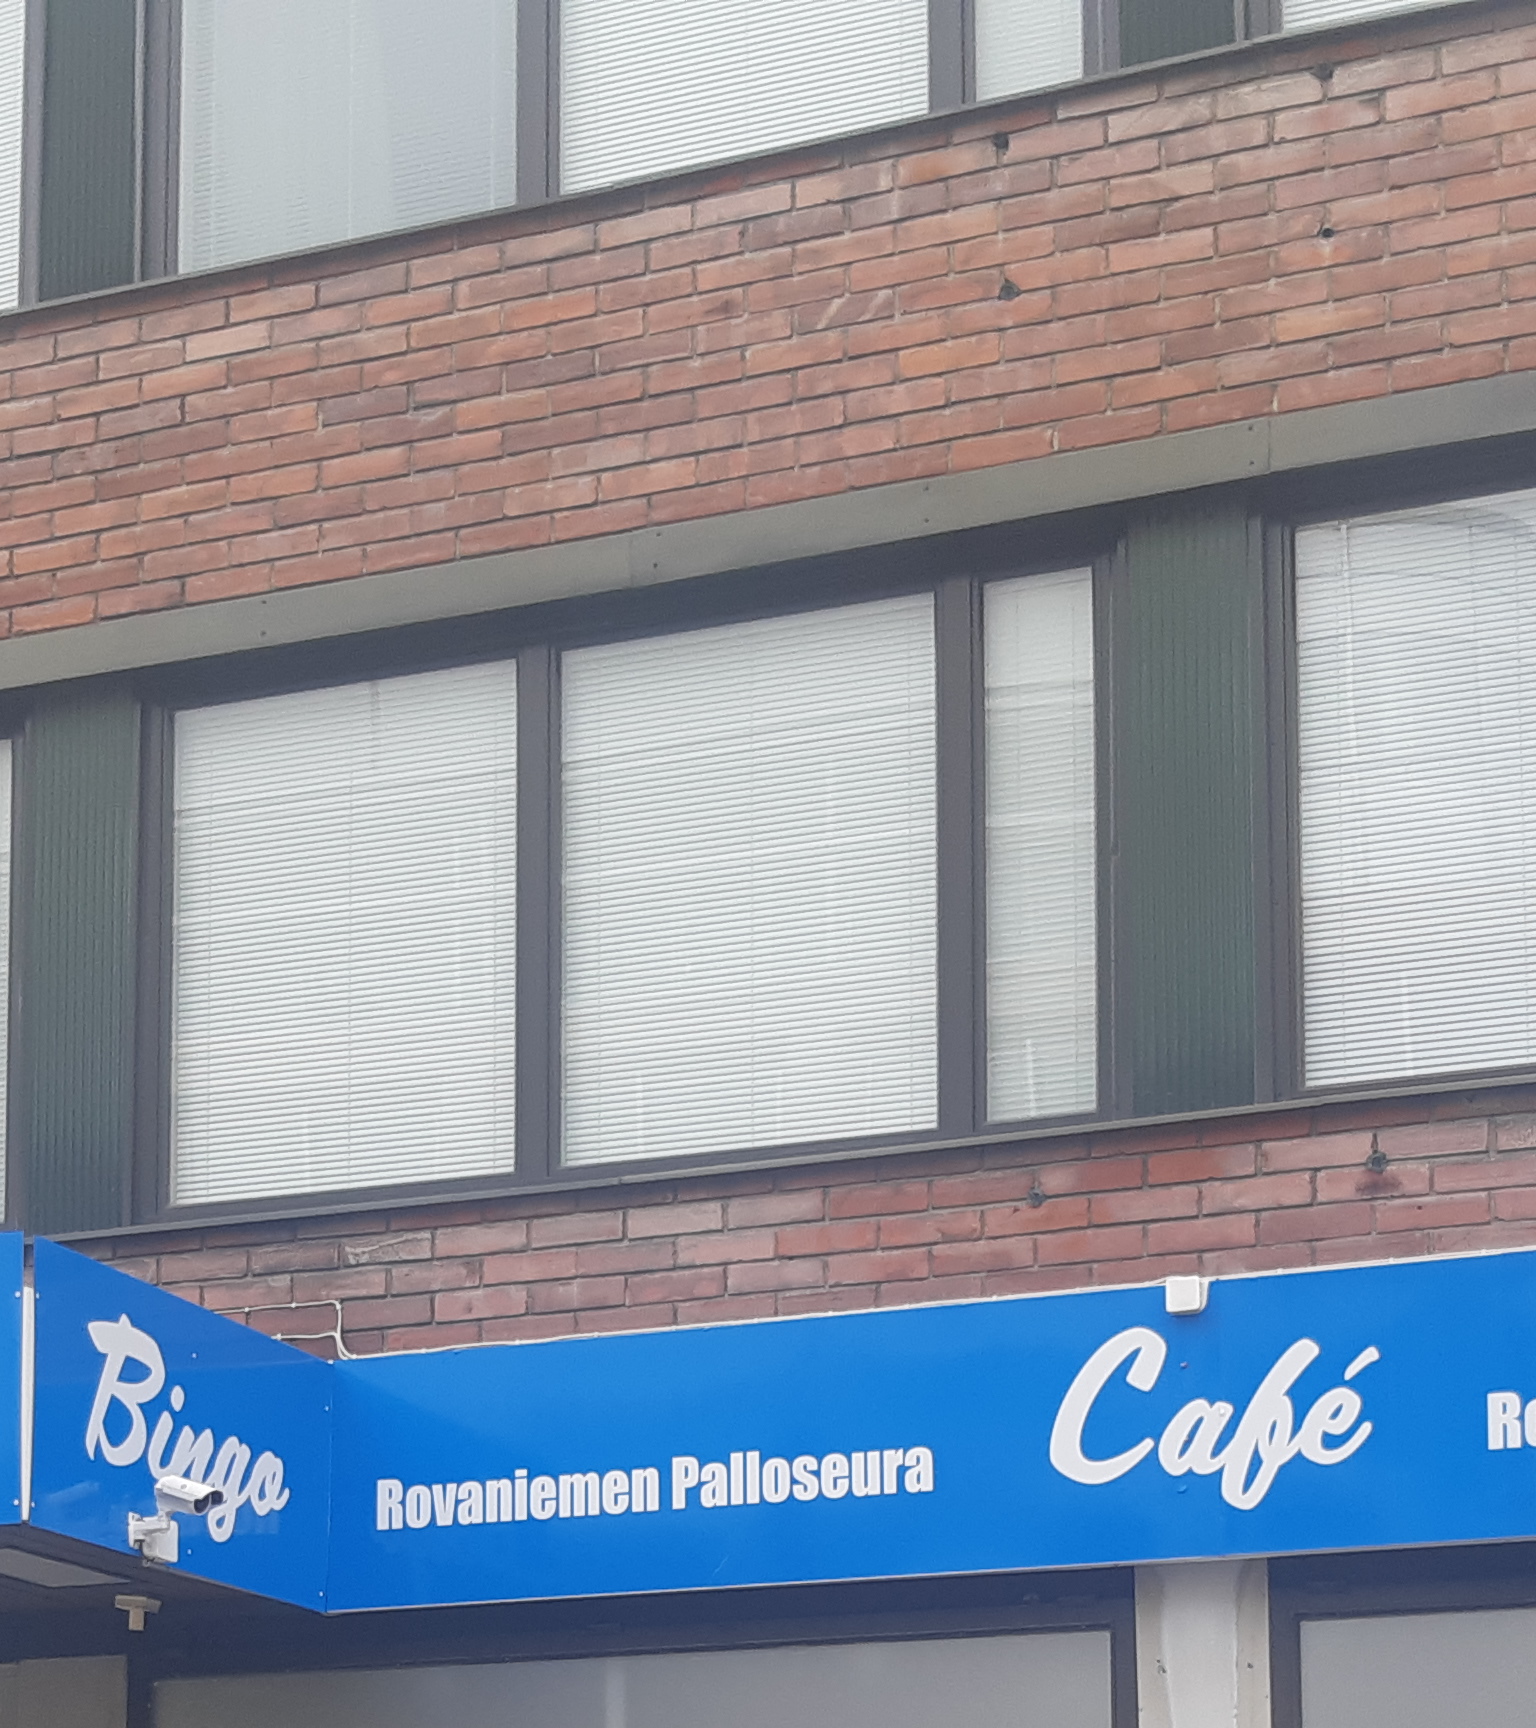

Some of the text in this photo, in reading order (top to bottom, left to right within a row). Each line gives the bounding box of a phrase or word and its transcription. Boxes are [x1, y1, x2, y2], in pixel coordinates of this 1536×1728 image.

[86, 1313, 290, 1544] Bingo
[375, 1439, 934, 1532] Rovaniemen Palloseura
[1048, 1326, 1381, 1511] Café
